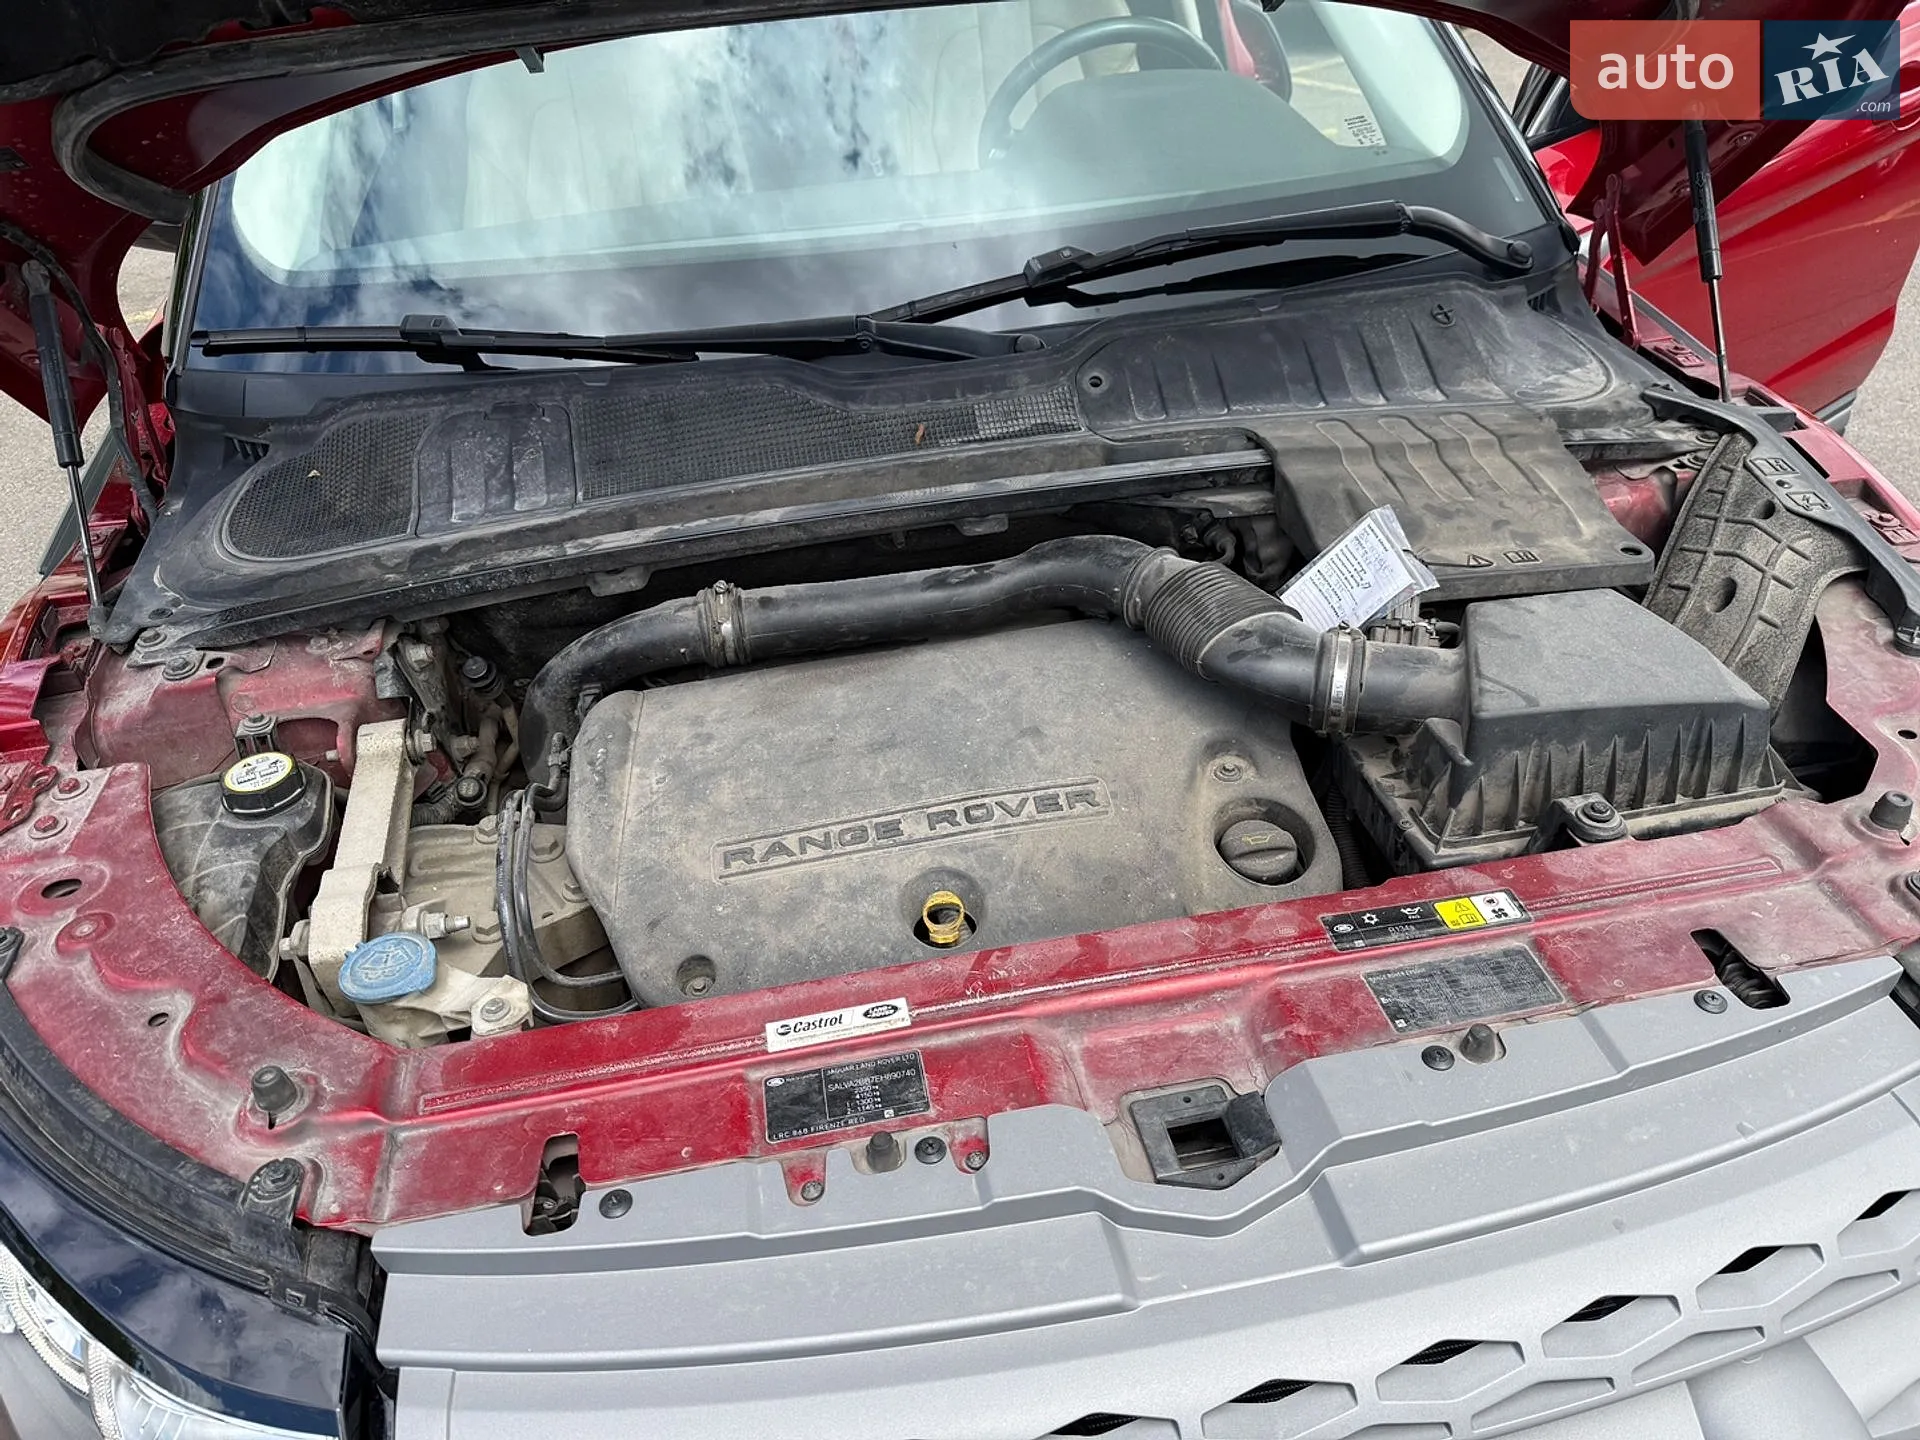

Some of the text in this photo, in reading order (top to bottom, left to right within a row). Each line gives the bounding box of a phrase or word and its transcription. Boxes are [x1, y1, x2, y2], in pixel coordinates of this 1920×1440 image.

[723, 788, 1100, 869] RANGE ROVER
[793, 1013, 843, 1033] Castrol
[773, 1130, 790, 1140] LRC
[810, 1120, 845, 1133] FIRENZE
[848, 1116, 866, 1125] RED
